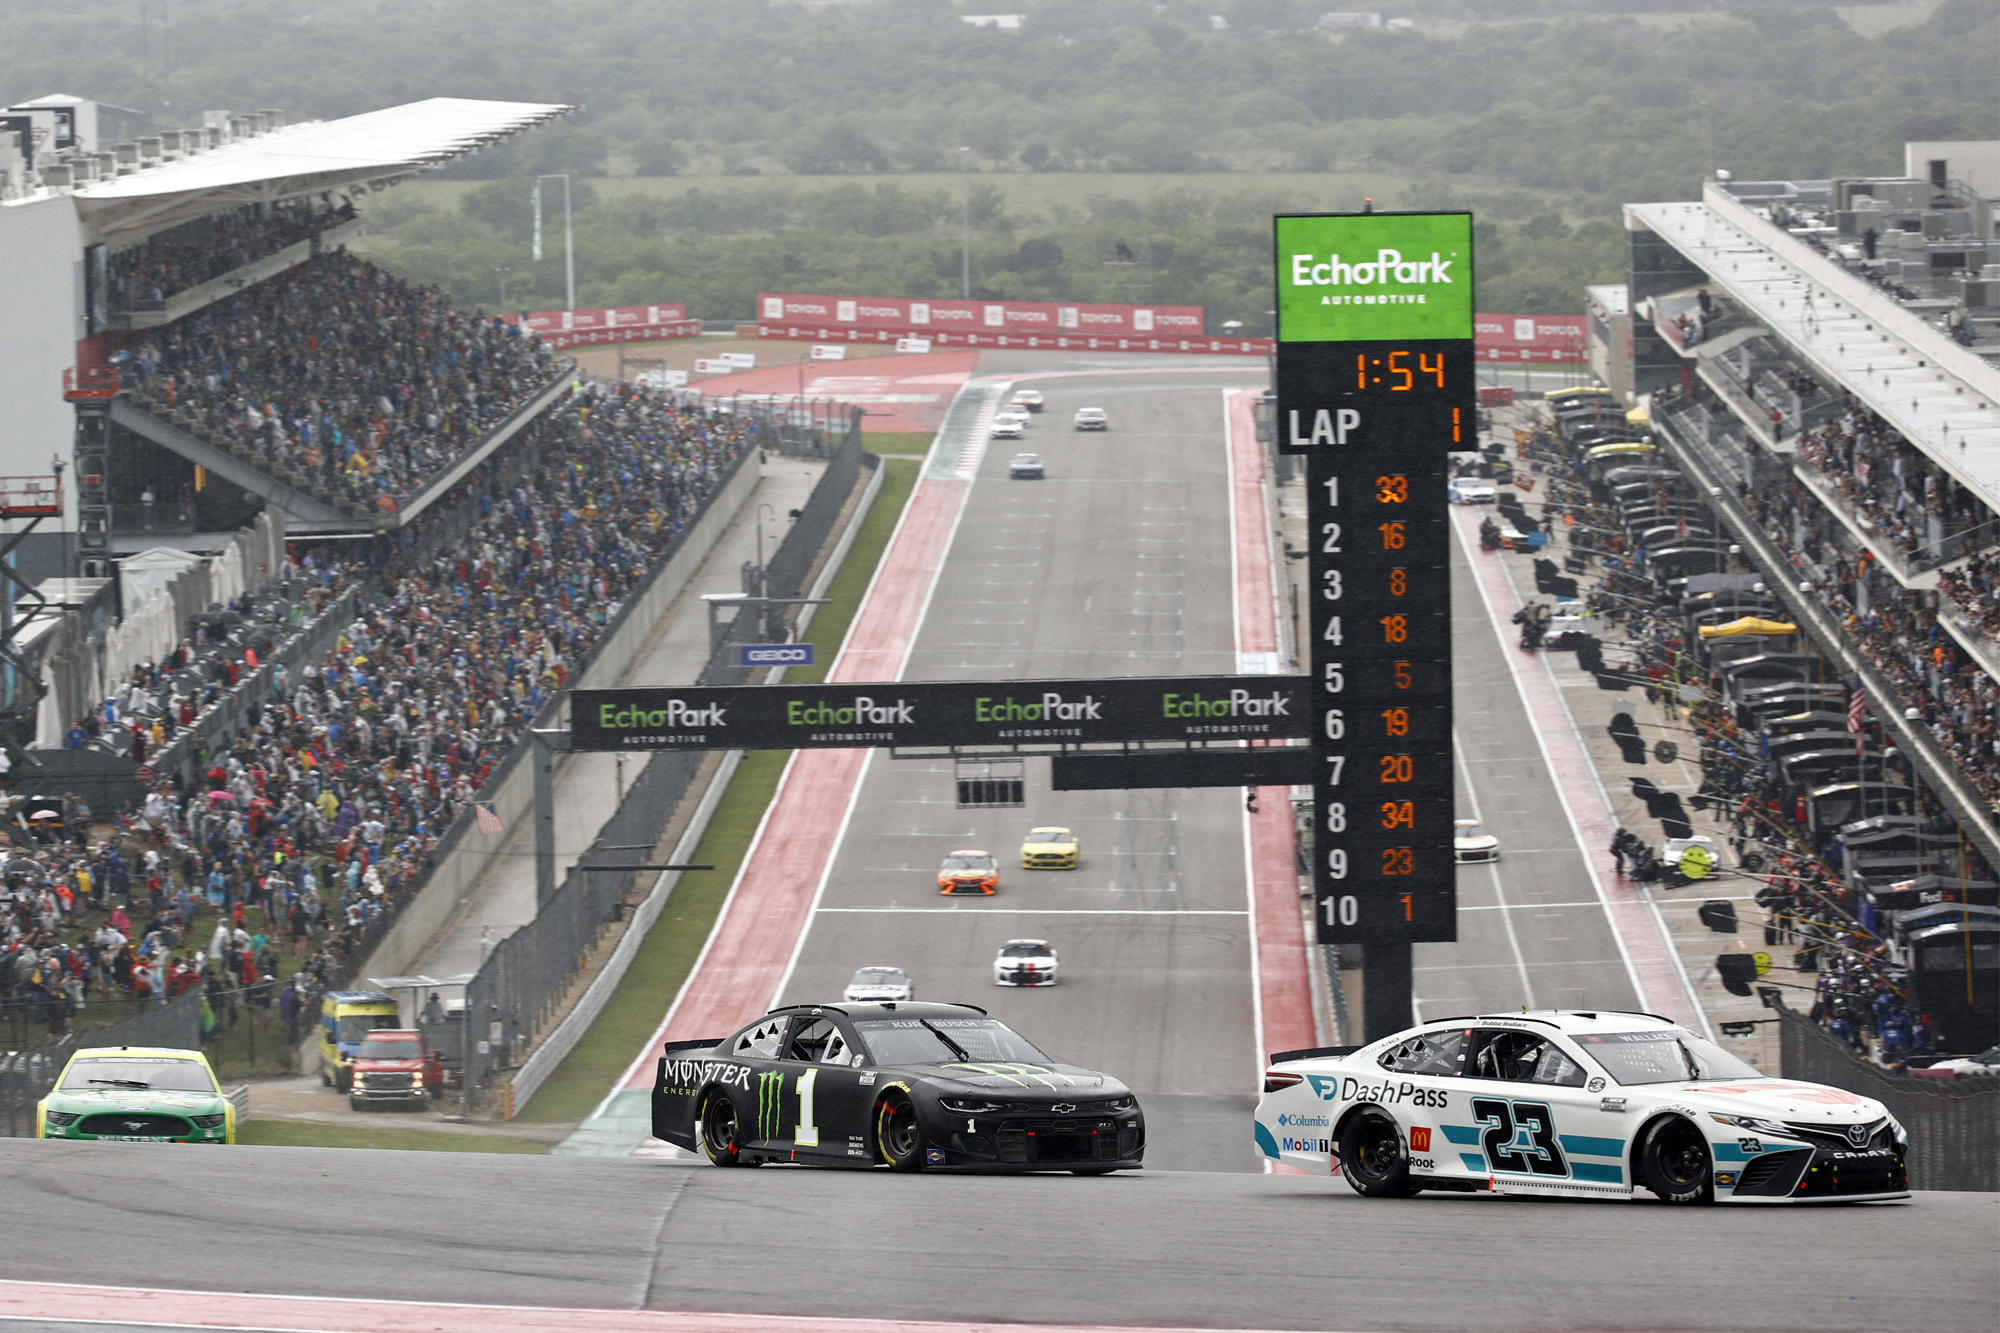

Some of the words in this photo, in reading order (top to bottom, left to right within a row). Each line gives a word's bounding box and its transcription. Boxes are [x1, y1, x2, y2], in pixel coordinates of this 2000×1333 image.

[1292, 249, 1453, 286] EchoPark
[785, 304, 827, 315] TOYOTA
[859, 306, 900, 317] TOYOTA
[1321, 294, 1427, 305] AUTOMOTIVE
[932, 309, 974, 319] TOYOTA
[1006, 311, 1048, 322] TOYOTA
[1081, 313, 1123, 324] TOYOTA
[1156, 315, 1199, 326] TOYOTA
[1536, 325, 1581, 335] TOYOTA
[1358, 351, 1444, 391] 1:54
[1289, 409, 1361, 446] LAP
[1453, 408, 1460, 442] 1
[1323, 477, 1339, 506] 1
[1322, 524, 1342, 553] 2
[1379, 523, 1405, 549] 16
[1323, 570, 1343, 600] 3
[1390, 569, 1407, 596] 8
[1324, 616, 1343, 645] 4
[1380, 616, 1407, 643] 18
[749, 649, 806, 661] GEICO
[1325, 663, 1344, 693] 5
[1395, 662, 1412, 689] 5
[600, 699, 728, 728] EchoPark
[787, 697, 915, 725] EchoPark
[975, 693, 1103, 722] EchoPark
[1163, 689, 1290, 718] EchoPark
[811, 733, 894, 741] AUTOMOTIVE
[998, 728, 1082, 737] AUTOMOTIVE
[1186, 724, 1269, 733] AUTOMOTIVE
[1325, 709, 1345, 739] 6
[1381, 709, 1409, 736] 19
[623, 736, 707, 744] AUTOMOTIVE
[1326, 756, 1345, 785] 7
[1380, 756, 1413, 783] 20
[1328, 802, 1346, 832] 8
[1381, 802, 1414, 829] 34
[1328, 849, 1347, 879] 9
[1381, 849, 1414, 875] 23
[1320, 895, 1359, 925] 10
[1400, 895, 1412, 921] 1
[892, 1020, 930, 1028] KUR
[932, 1020, 978, 1028] BUSCH
[665, 1059, 752, 1091] MONSTER
[1341, 1077, 1448, 1108] DashPass
[794, 1068, 819, 1147] 1
[1288, 1114, 1330, 1127] Columbia
[967, 1119, 976, 1133] 1
[1471, 1098, 1569, 1178] 23
[1283, 1137, 1317, 1151] Mobil
[1738, 1138, 1763, 1152] 23
[1833, 1150, 1887, 1159] CAMRY
[1409, 1156, 1435, 1169] Root
